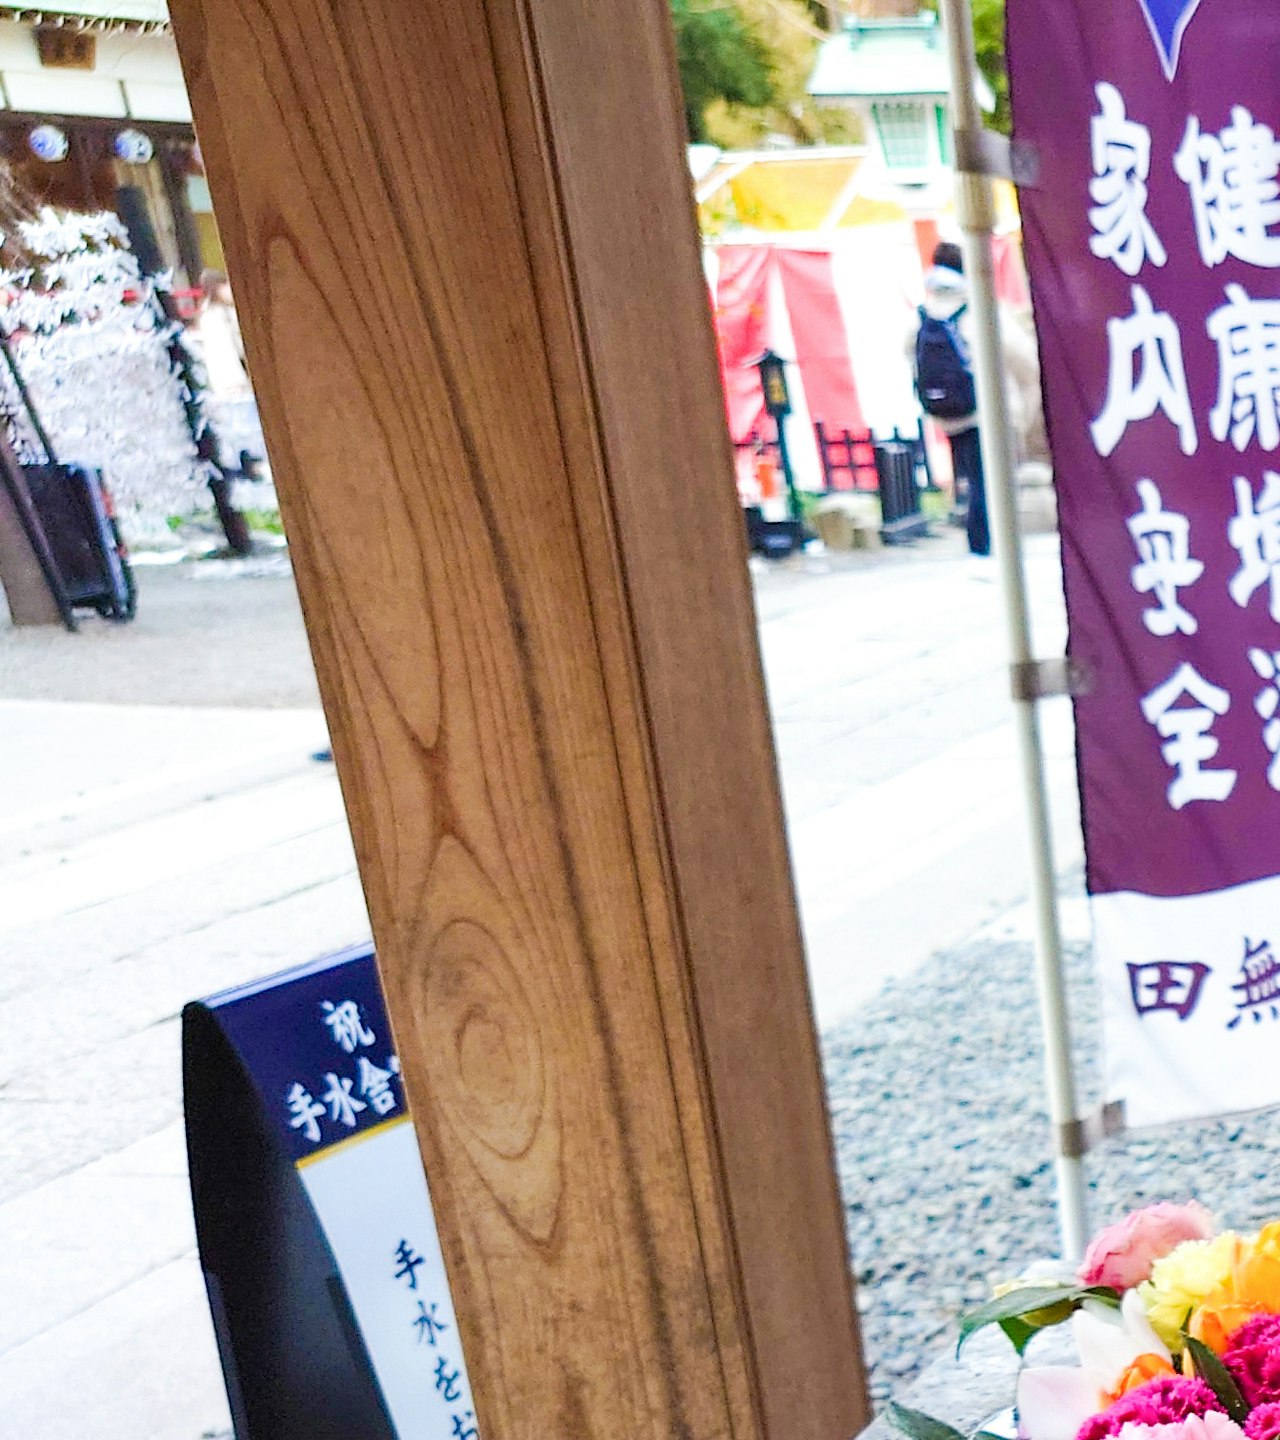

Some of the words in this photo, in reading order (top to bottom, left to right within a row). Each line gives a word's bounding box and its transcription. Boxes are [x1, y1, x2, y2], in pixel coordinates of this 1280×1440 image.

[321, 1000, 376, 1053] 祝
[287, 1054, 402, 1142] 手水舎
